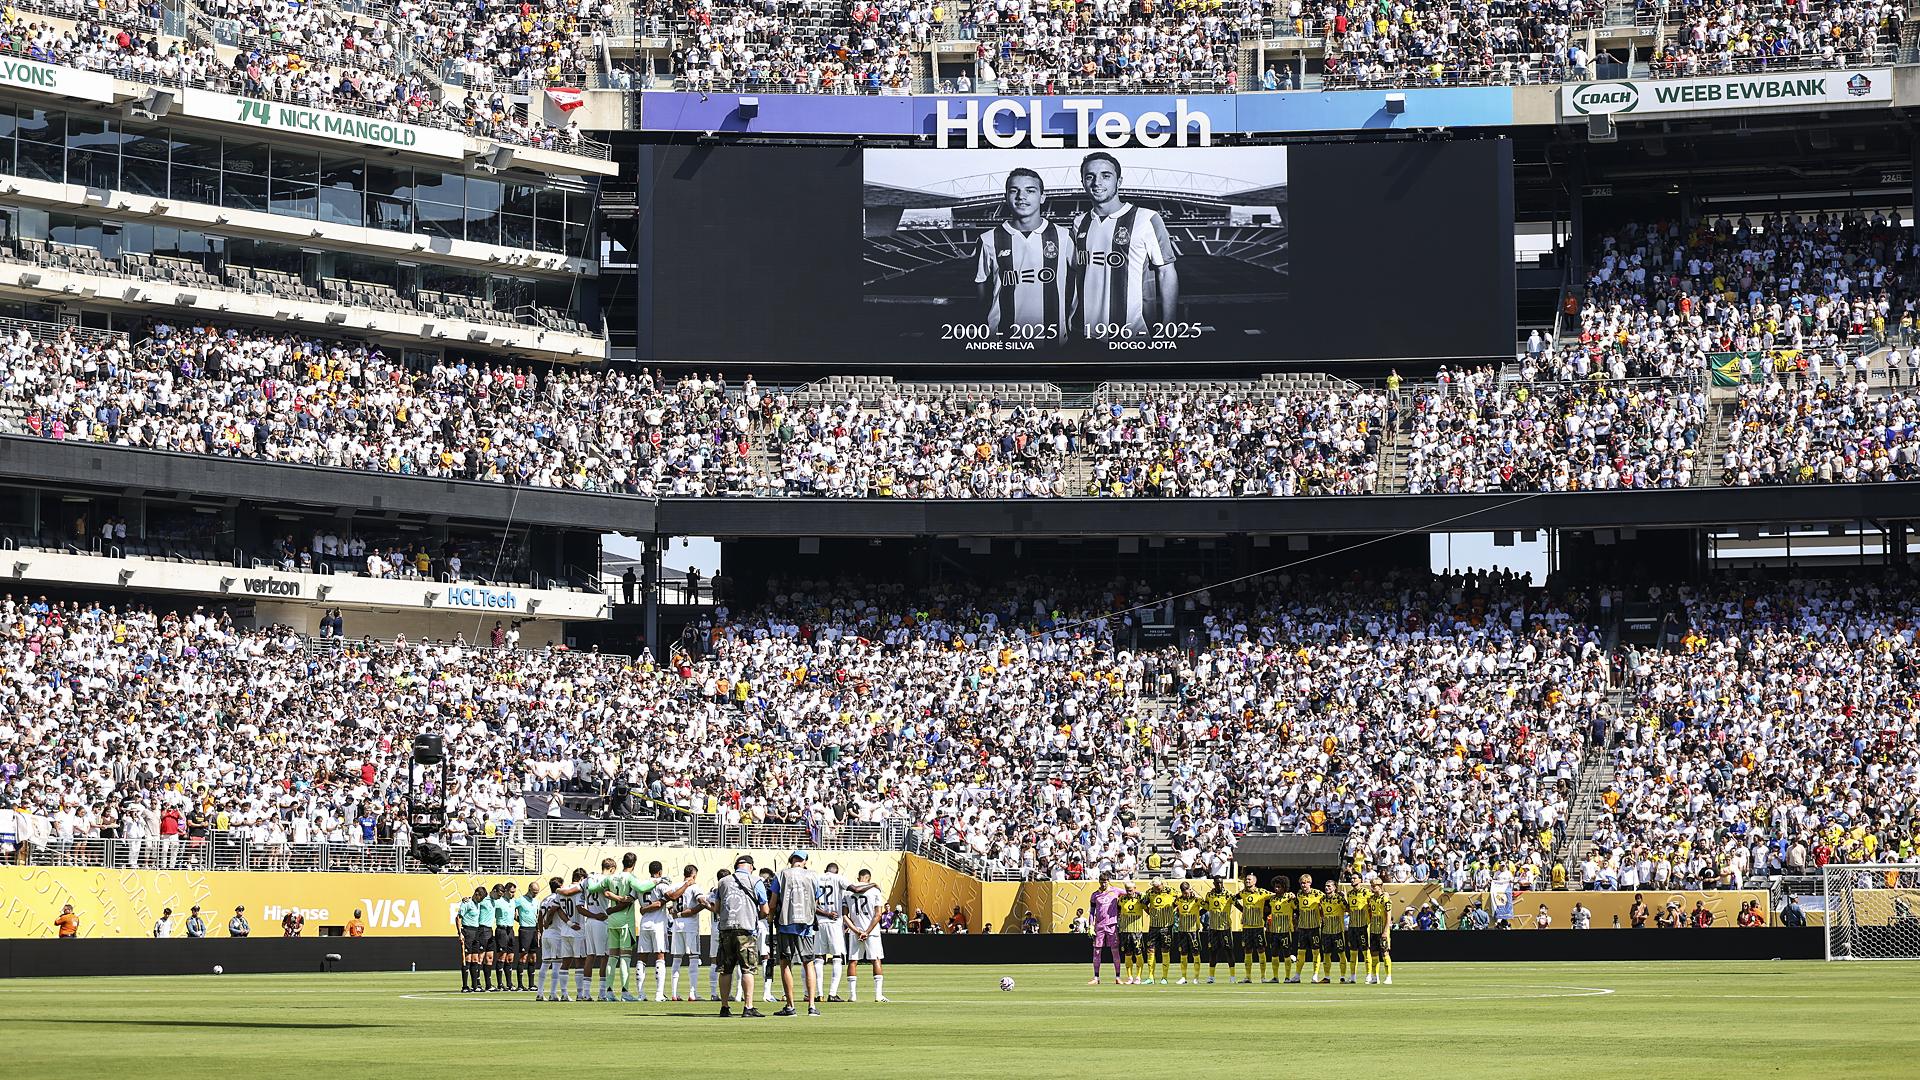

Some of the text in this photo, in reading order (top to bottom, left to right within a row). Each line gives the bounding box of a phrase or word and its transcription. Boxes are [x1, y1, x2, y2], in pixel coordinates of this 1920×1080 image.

[0, 61, 57, 87] YONS
[1580, 78, 1827, 105] COACH WEEB EWBANK
[237, 99, 416, 147] 74 NICK MANGOLD
[936, 98, 1212, 149] HCLTech
[941, 323, 990, 340] 2000
[1009, 323, 1058, 340] 2025
[1084, 322, 1133, 340] 1996
[1152, 322, 1202, 339] 2025
[965, 339, 1035, 350] ANDRÉ SILVA
[1109, 341, 1177, 350] DIOGO JOTA
[243, 575, 300, 596] verizon
[448, 587, 517, 609] HCLTech
[263, 905, 329, 921] Hisnse
[360, 898, 422, 928] VISA
